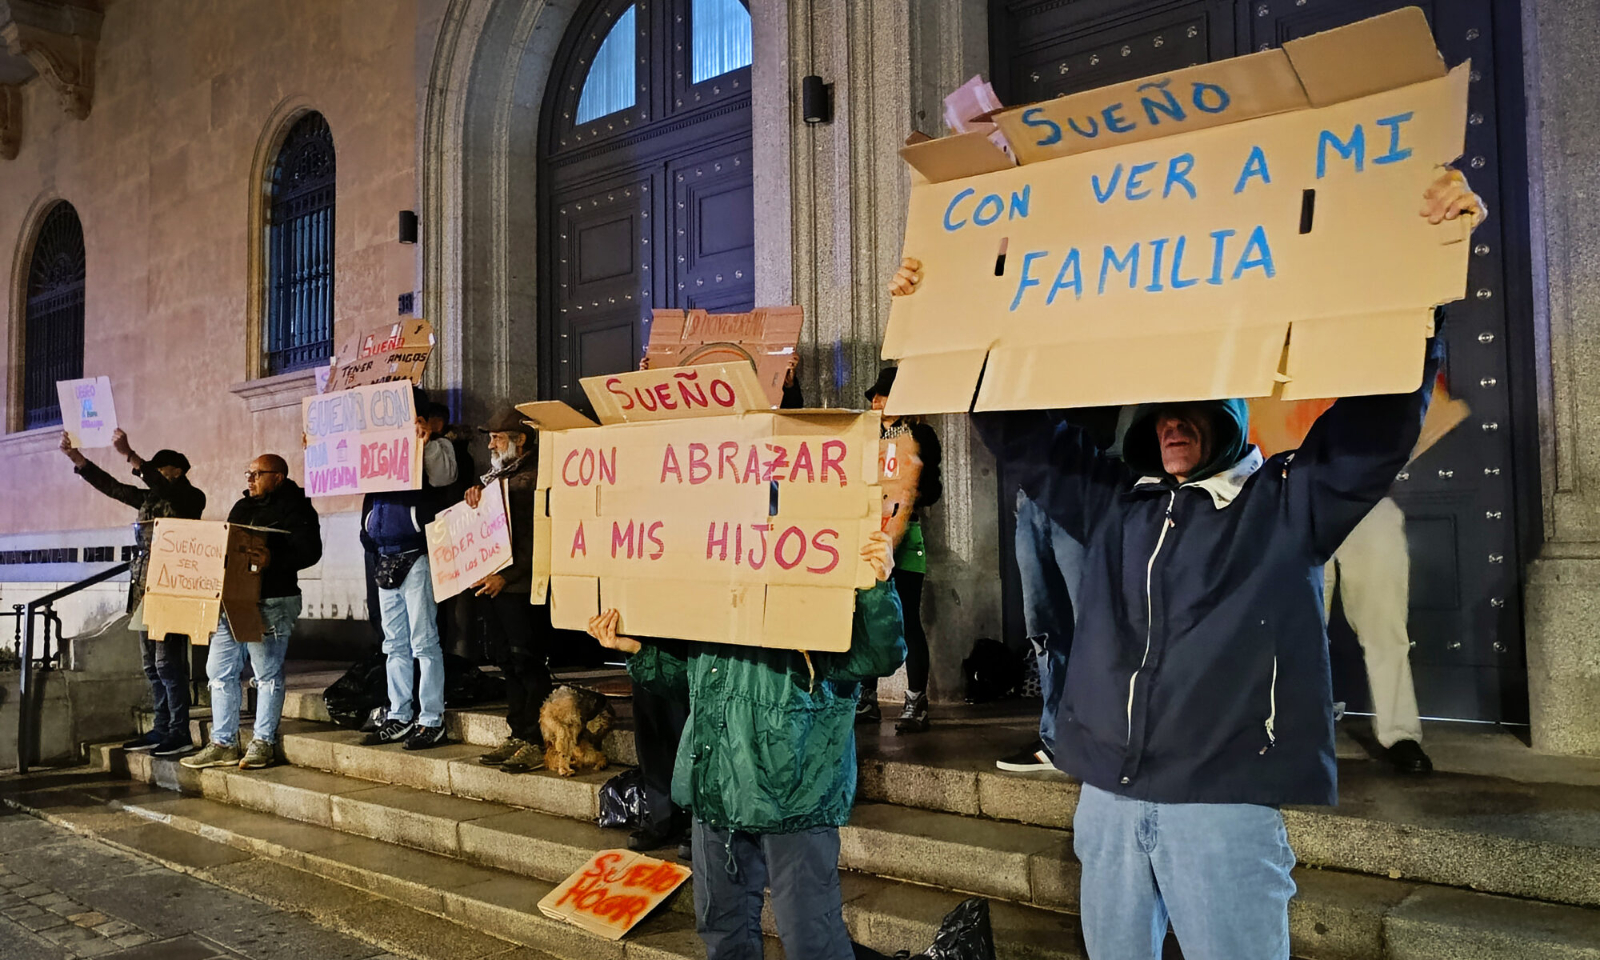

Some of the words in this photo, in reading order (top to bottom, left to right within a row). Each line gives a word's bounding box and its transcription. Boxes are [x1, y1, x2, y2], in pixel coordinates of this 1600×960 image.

[1021, 80, 1230, 146] SUEÑO
[943, 185, 1031, 231] CON
[1091, 153, 1197, 204] VER
[1234, 146, 1271, 194] A
[1315, 111, 1413, 179] MI
[1009, 225, 1276, 311] FAMILIA
[342, 361, 373, 378] TENER
[387, 352, 427, 364] AMIGOS
[370, 385, 411, 429] CON
[605, 370, 736, 411] SUEÑO
[309, 466, 358, 494] VIVIENDA
[360, 437, 410, 483] DIGNA
[562, 446, 617, 487] CON
[660, 440, 848, 487] ABRAZAR
[160, 530, 204, 556] SUEÑO
[204, 544, 222, 559] CON
[177, 558, 198, 572] SER
[433, 532, 475, 567] PODER
[570, 519, 587, 558] A
[611, 519, 665, 560] MIS
[706, 520, 839, 574] HIJOS
[555, 875, 650, 930] HOGAR
